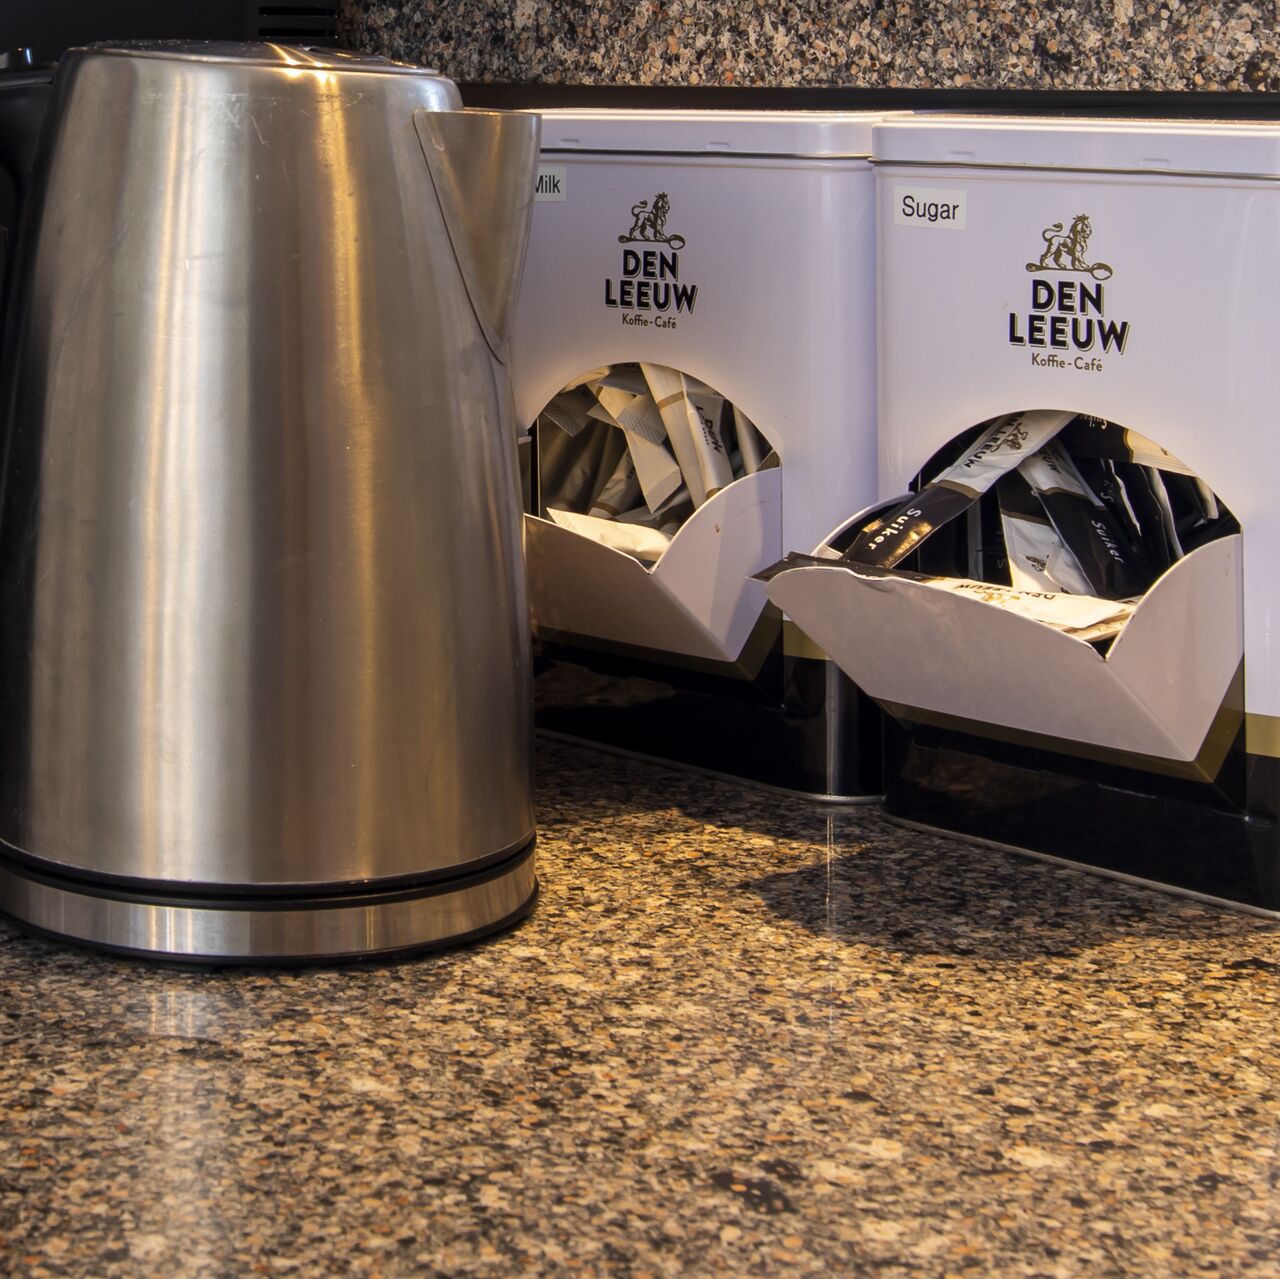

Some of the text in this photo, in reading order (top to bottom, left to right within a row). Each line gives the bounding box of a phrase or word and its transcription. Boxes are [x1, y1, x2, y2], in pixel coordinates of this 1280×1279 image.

[902, 195, 960, 222] Sugar
[623, 249, 679, 281] DEN
[604, 278, 699, 315] LEEUW
[1032, 279, 1105, 317] DEN
[1009, 312, 1131, 355] LEEUW
[867, 507, 923, 551] Suiker
[1090, 519, 1125, 565] Suiker
